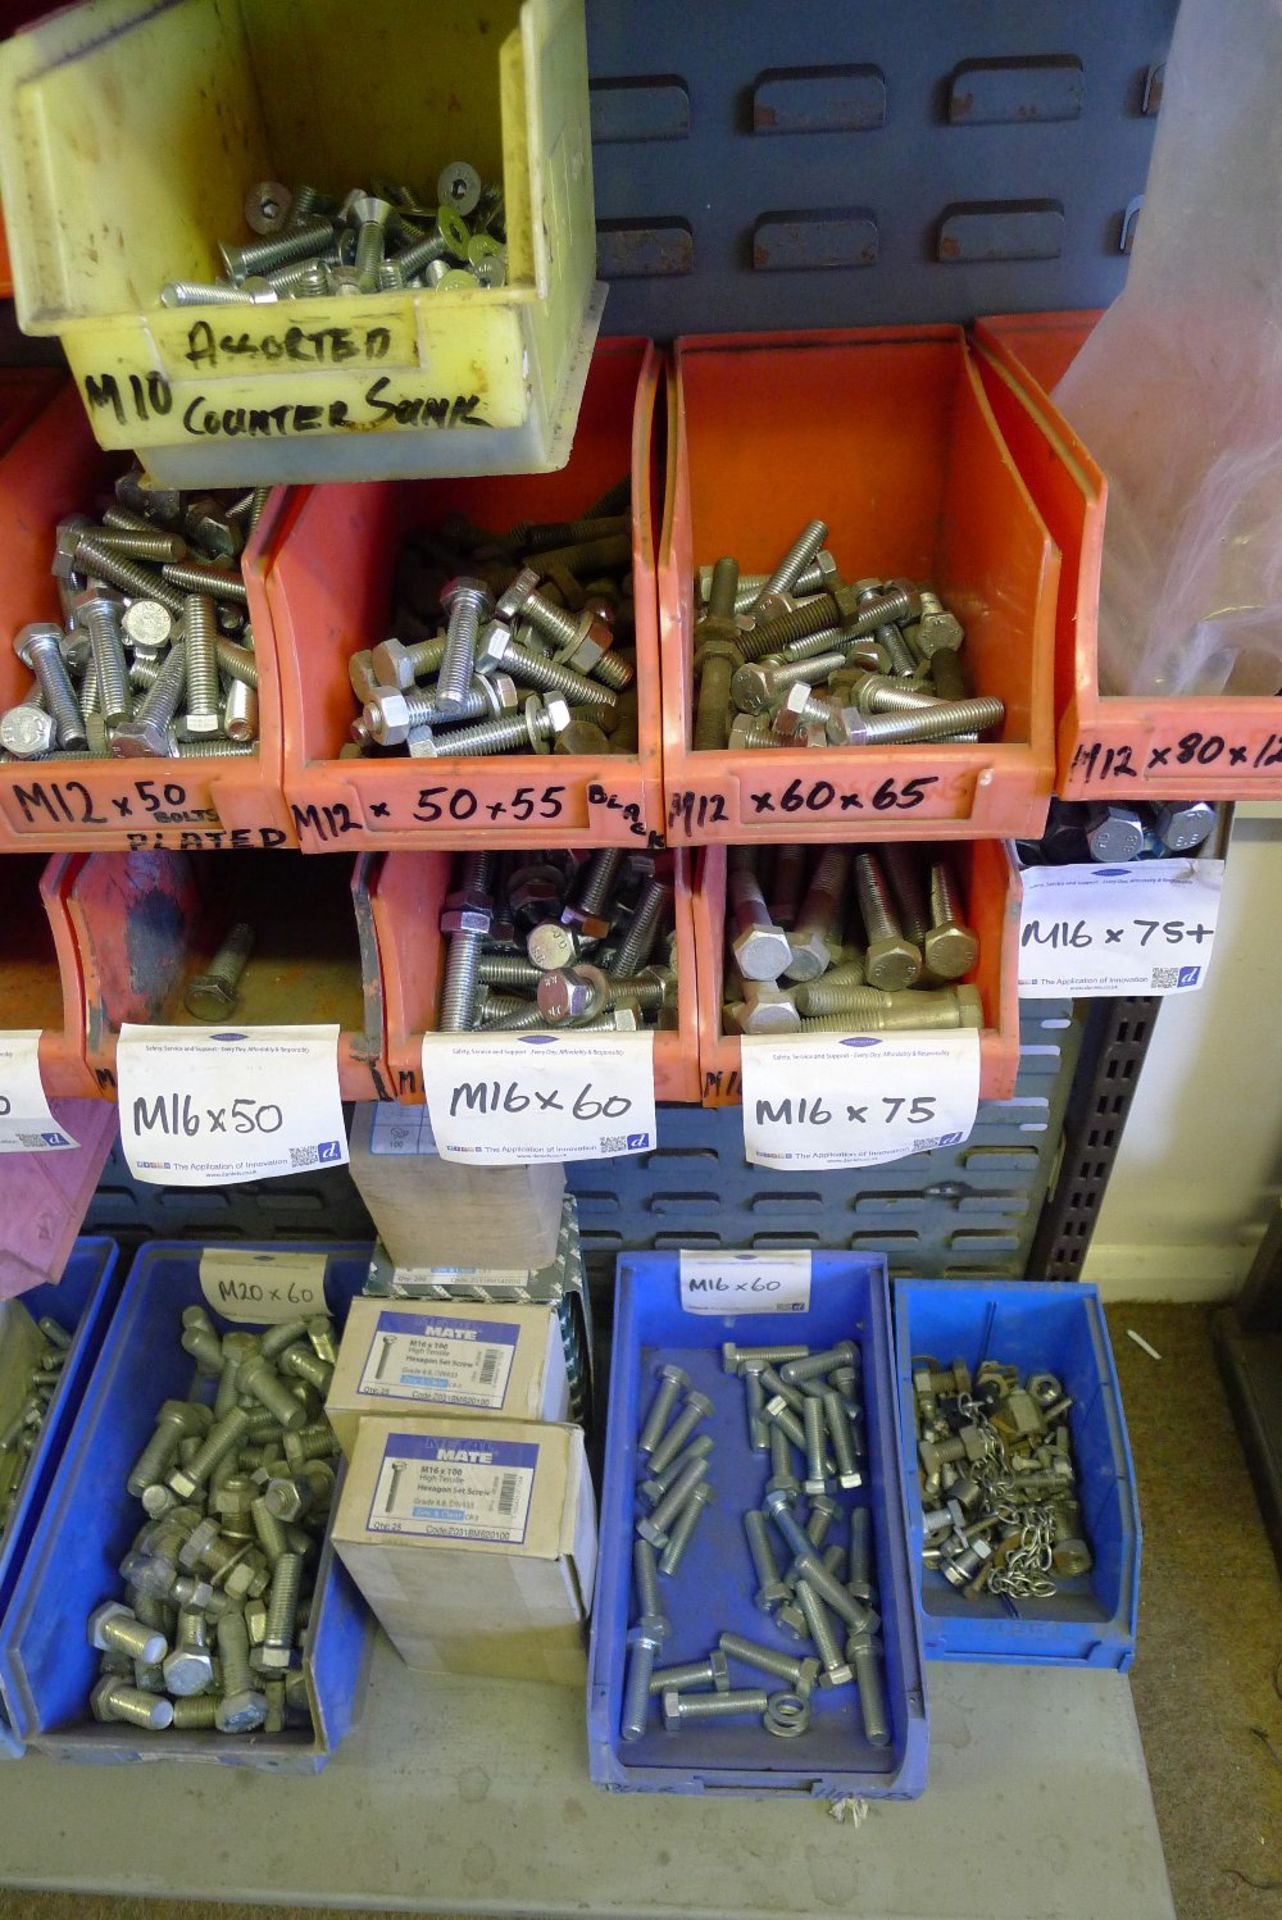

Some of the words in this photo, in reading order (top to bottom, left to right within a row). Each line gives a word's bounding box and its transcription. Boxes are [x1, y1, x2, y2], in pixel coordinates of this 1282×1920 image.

[85, 370, 173, 426] M10
[183, 396, 348, 436] COUNTER
[1070, 743, 1137, 783] M12
[12, 781, 107, 823] M12
[668, 791, 729, 838] M12
[153, 811, 220, 824] BOLTS
[291, 804, 362, 841] M12
[1021, 920, 1093, 949] M16
[756, 1097, 832, 1125] M16
[881, 1096, 936, 1124] 75
[218, 1280, 264, 1302] M20
[288, 1283, 314, 1304] 60
[688, 1277, 729, 1292] M16
[424, 1326, 478, 1341] MATE
[420, 1465, 439, 1474] M16
[436, 1448, 493, 1464] MATE
[417, 1485, 451, 1494] Hexagon
[467, 1488, 489, 1496] Screw
